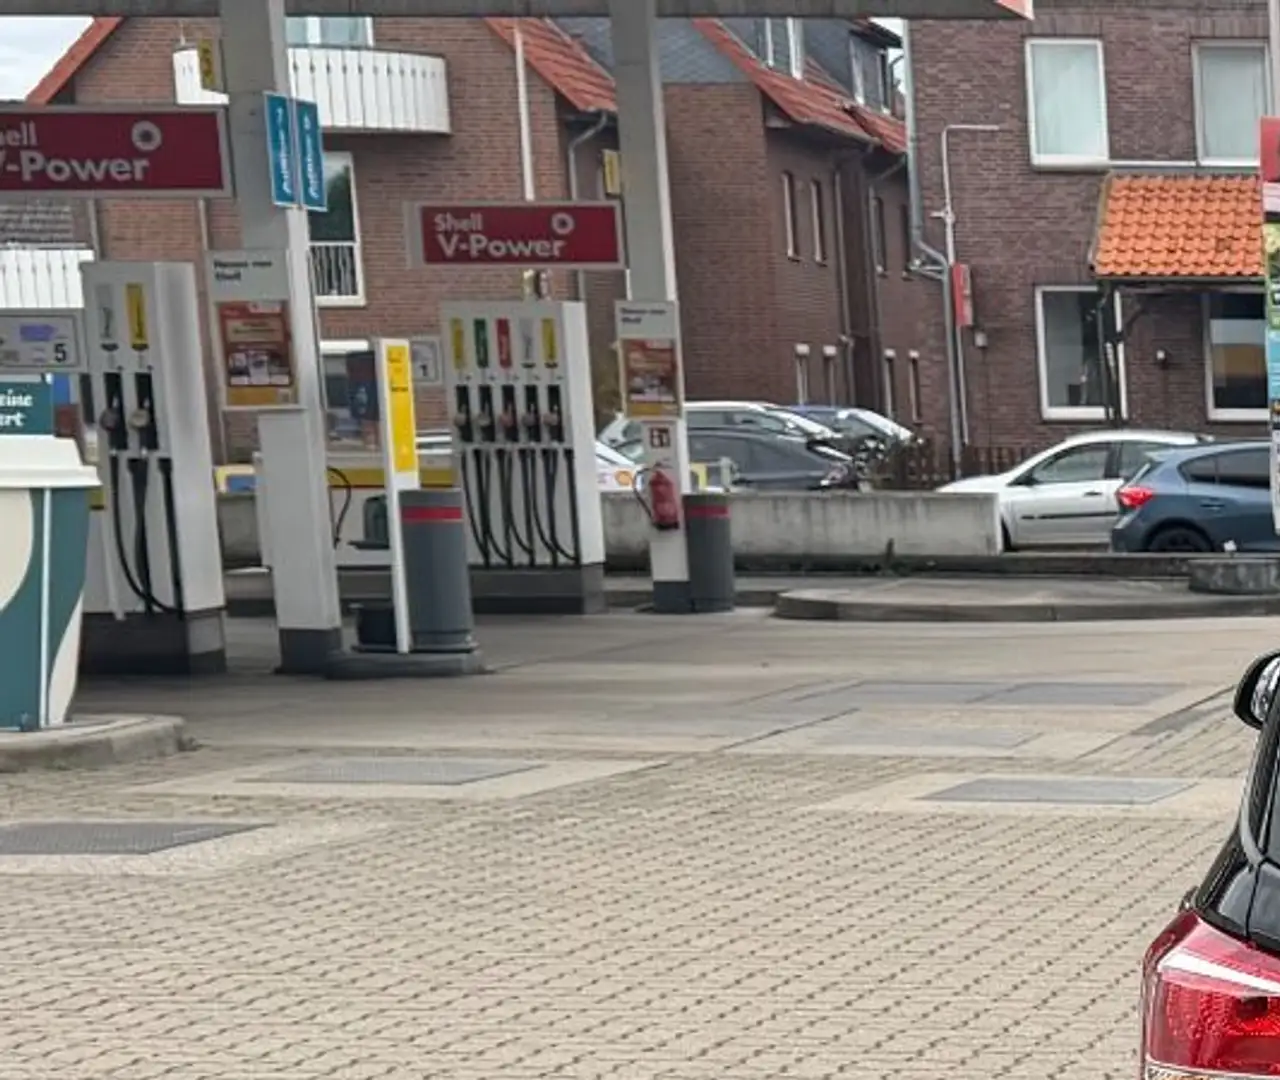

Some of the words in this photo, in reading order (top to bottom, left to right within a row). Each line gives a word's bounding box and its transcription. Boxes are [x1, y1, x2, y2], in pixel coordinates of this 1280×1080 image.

[0, 150, 149, 182] -Power
[434, 212, 483, 232] Shell
[437, 234, 567, 258] V-Power
[54, 343, 67, 362] 5
[419, 363, 429, 378] 1
